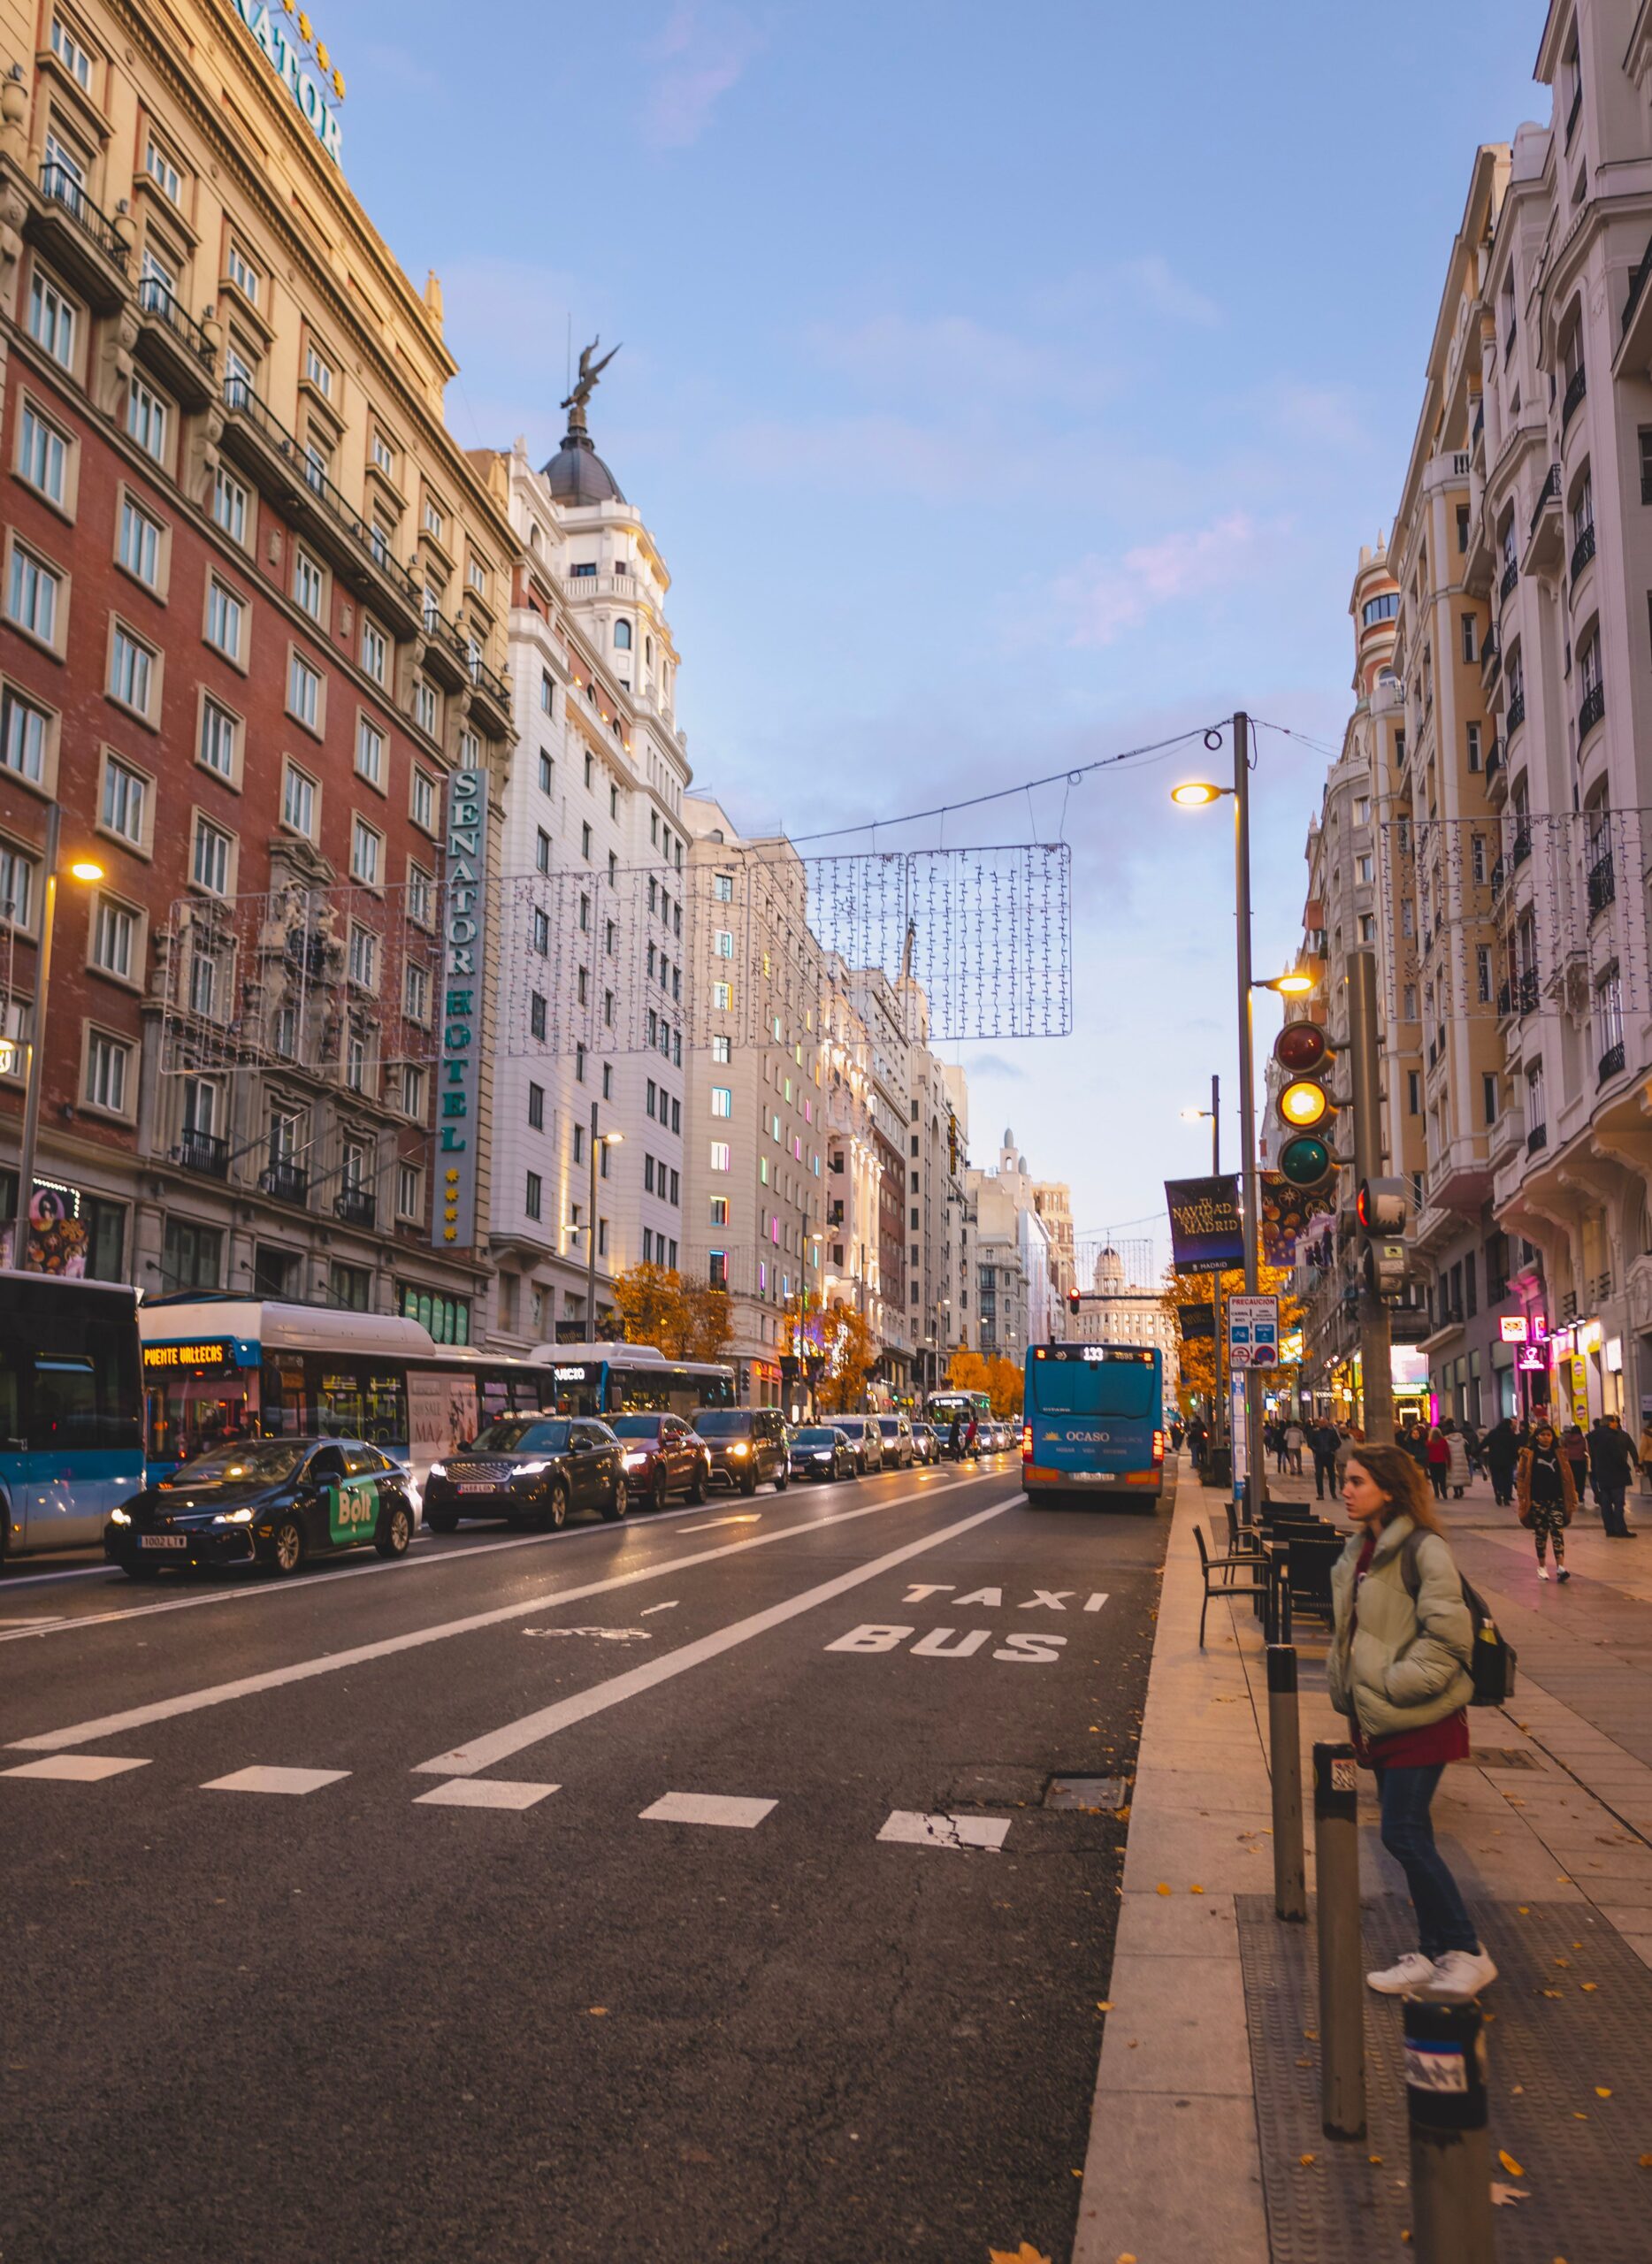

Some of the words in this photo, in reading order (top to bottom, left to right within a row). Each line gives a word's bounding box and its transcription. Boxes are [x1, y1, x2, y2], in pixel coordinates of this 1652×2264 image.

[446, 772, 479, 975] SENATOR
[440, 990, 473, 1152] HOTEL
[1173, 1203, 1232, 1220] NAVIDAD
[1184, 1220, 1238, 1235] MADRID
[144, 1347, 178, 1365] PUENTE
[1083, 1347, 1104, 1361] 133
[554, 1367, 585, 1381] VICIO
[1066, 1431, 1110, 1442] OCASO
[339, 1490, 371, 1525] Bolt
[901, 1584, 1110, 1611] TAXI
[823, 1624, 1067, 1663] BUS
